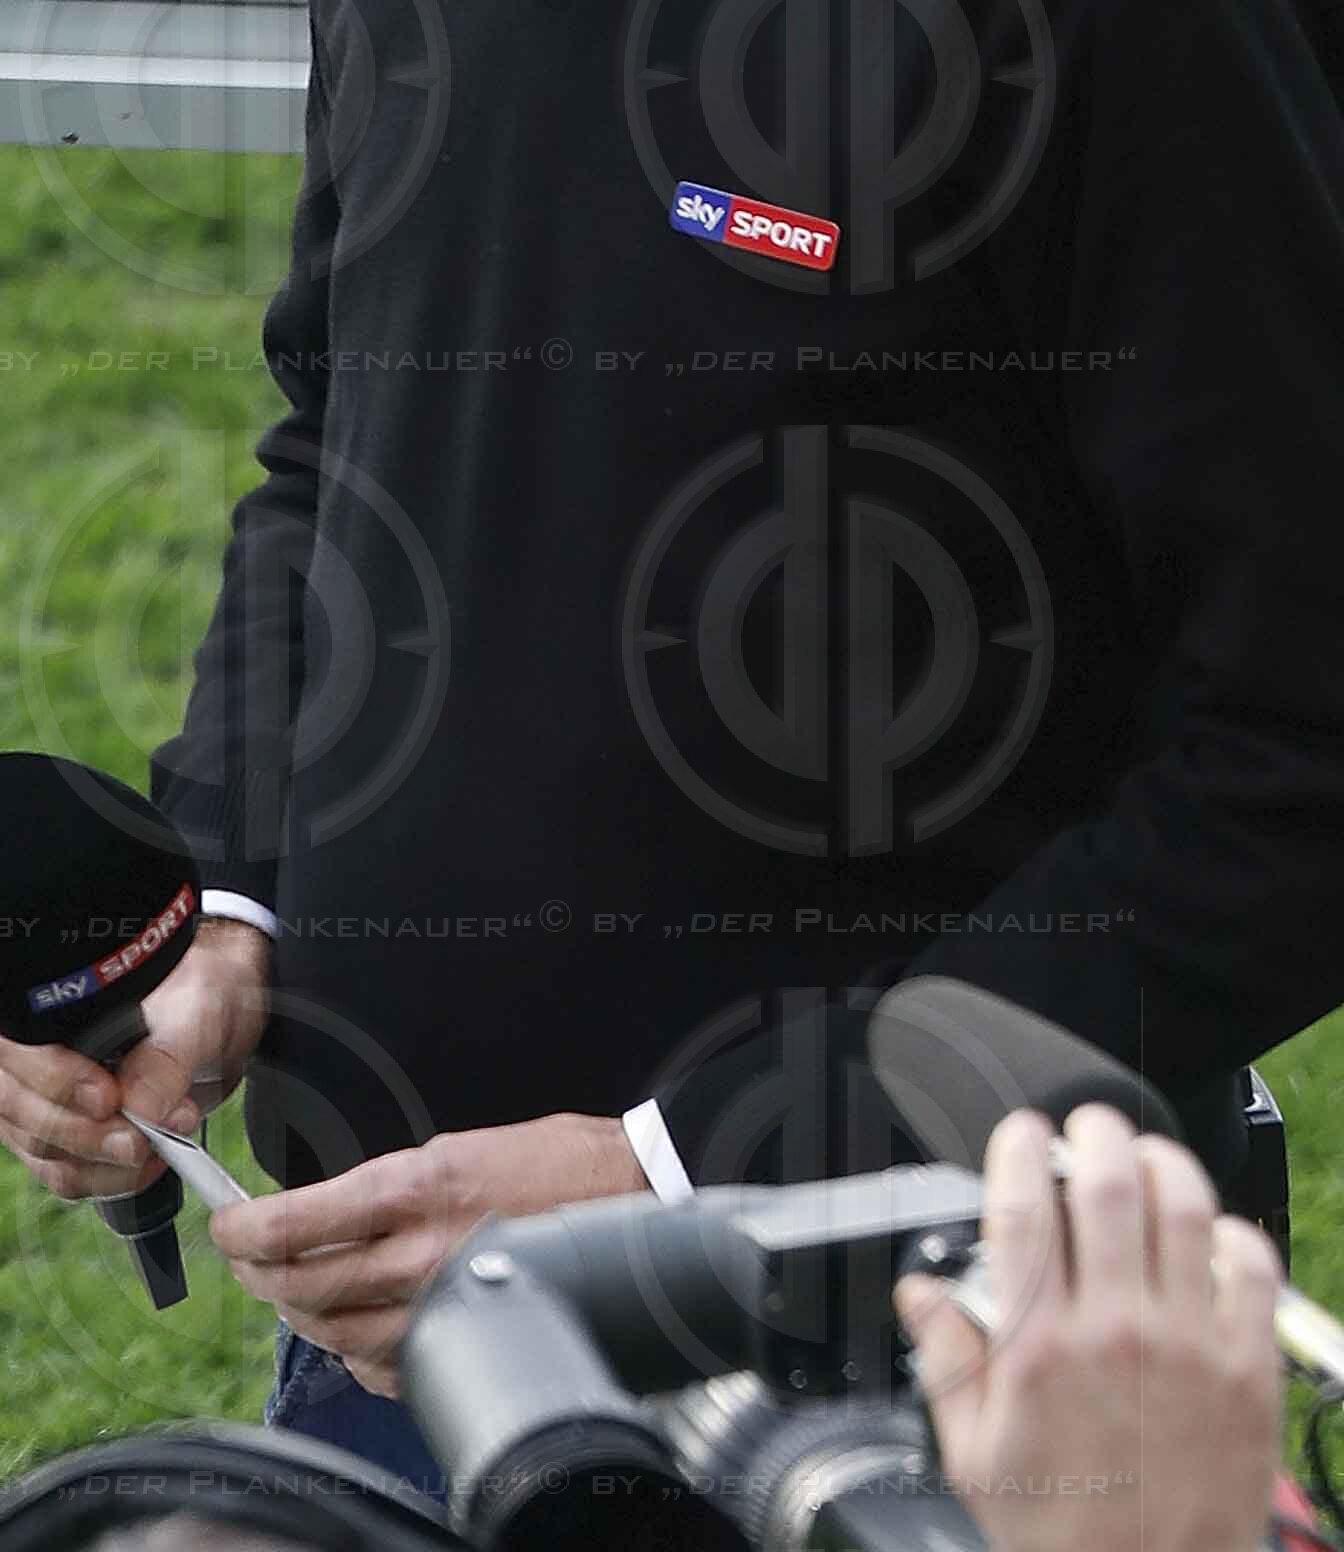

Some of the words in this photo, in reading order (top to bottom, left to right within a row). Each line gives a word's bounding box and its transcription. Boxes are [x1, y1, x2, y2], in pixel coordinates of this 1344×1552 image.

[675, 195, 726, 232] sky
[730, 210, 832, 258] SPORT
[35, 975, 88, 1007] sky
[100, 894, 189, 982] SPORT
